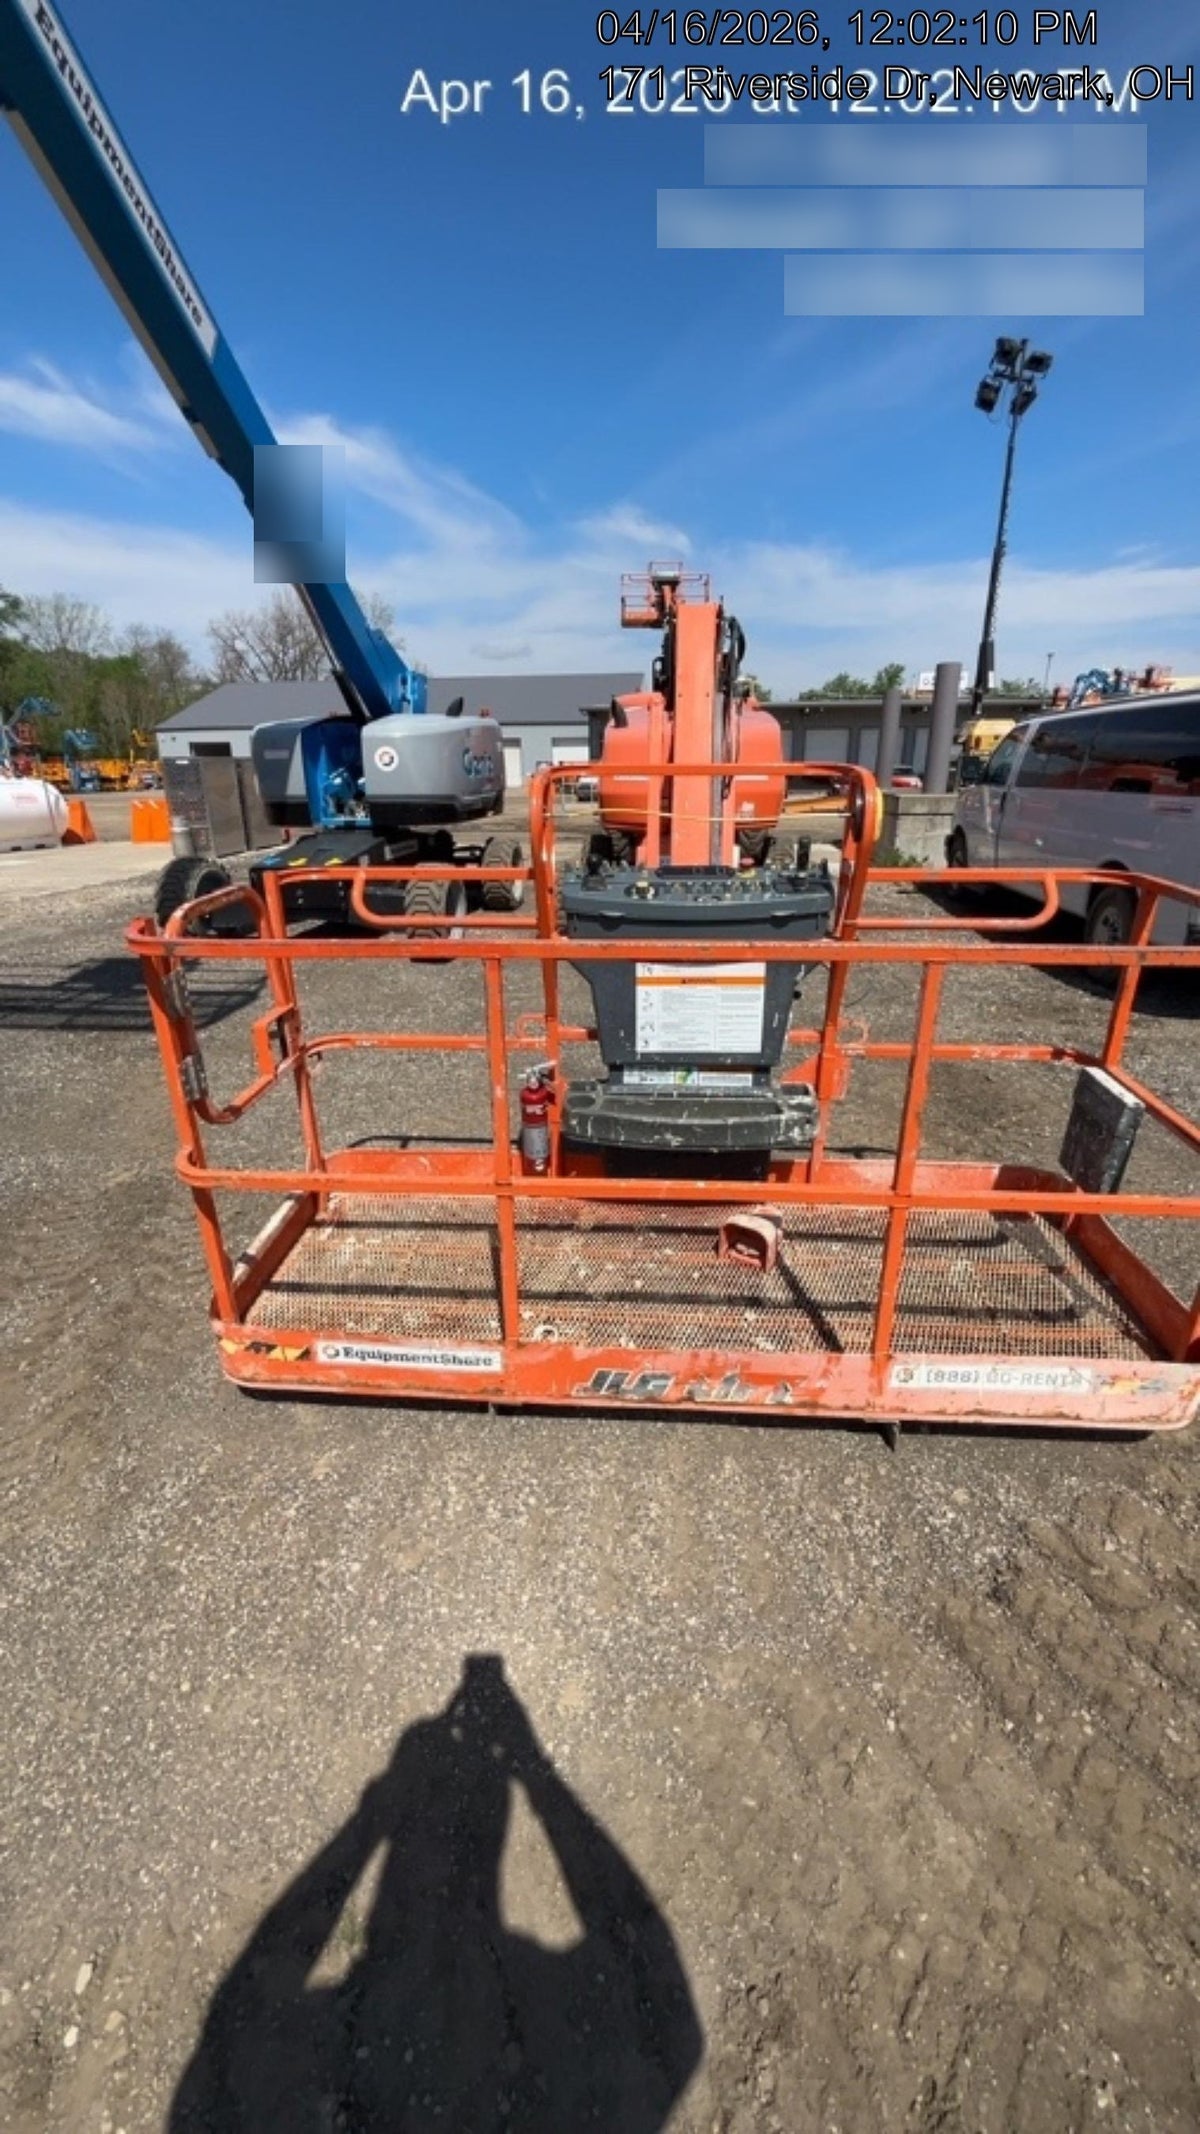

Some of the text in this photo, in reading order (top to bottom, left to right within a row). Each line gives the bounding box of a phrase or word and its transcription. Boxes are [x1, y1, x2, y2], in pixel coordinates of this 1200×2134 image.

[35, 0, 203, 328] EquipmentShare
[343, 1346, 493, 1367] EquipmentShare
[926, 1368, 980, 1384] (888)
